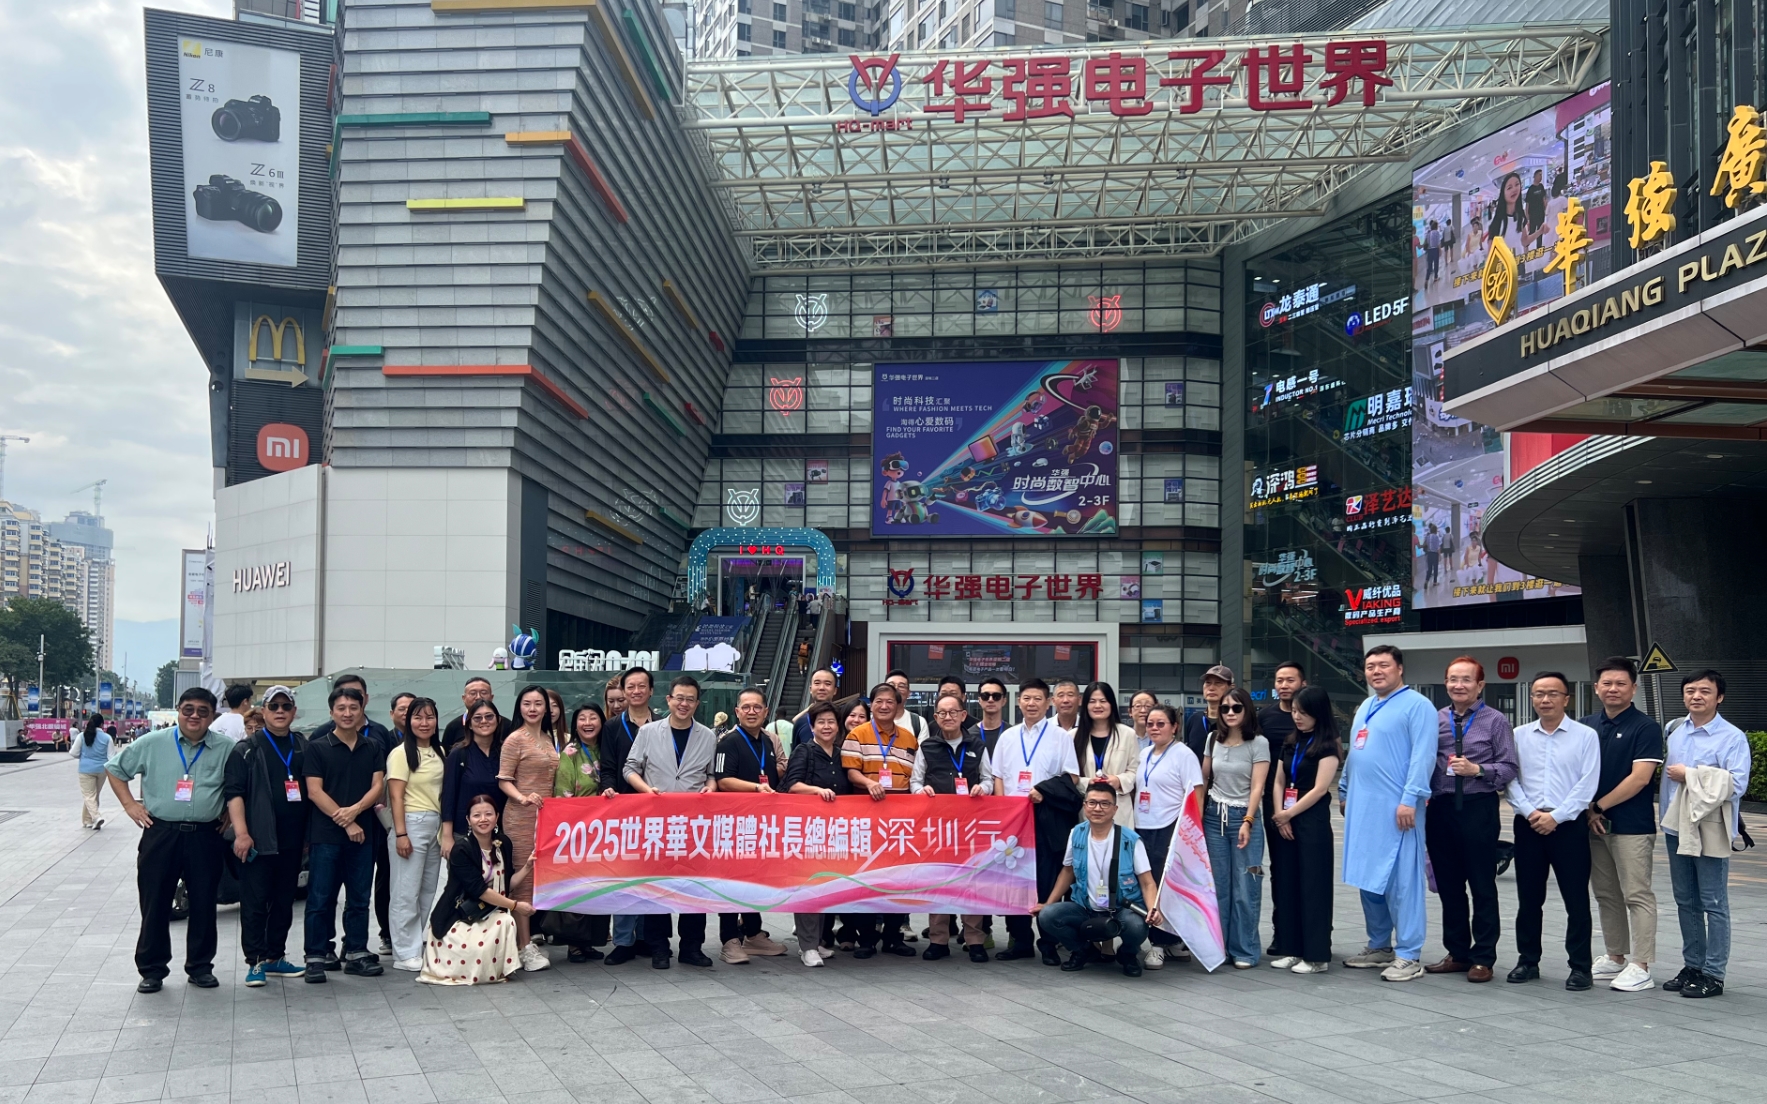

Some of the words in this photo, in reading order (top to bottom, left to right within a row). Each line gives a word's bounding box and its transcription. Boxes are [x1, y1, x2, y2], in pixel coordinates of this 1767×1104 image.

[204, 48, 223, 58] 尼康
[922, 40, 1393, 123] 华强电子世界
[1521, 276, 1665, 358] HUAQIANG
[1275, 369, 1319, 393] 电感一号
[893, 396, 951, 406] 时尚科技汇聚
[1011, 472, 1111, 491] 时尚数智中心
[1078, 495, 1110, 506] 2-3F
[233, 561, 291, 593] HUAWEI
[1293, 569, 1317, 582] 2-3F
[923, 573, 1104, 601] 华强电子世界
